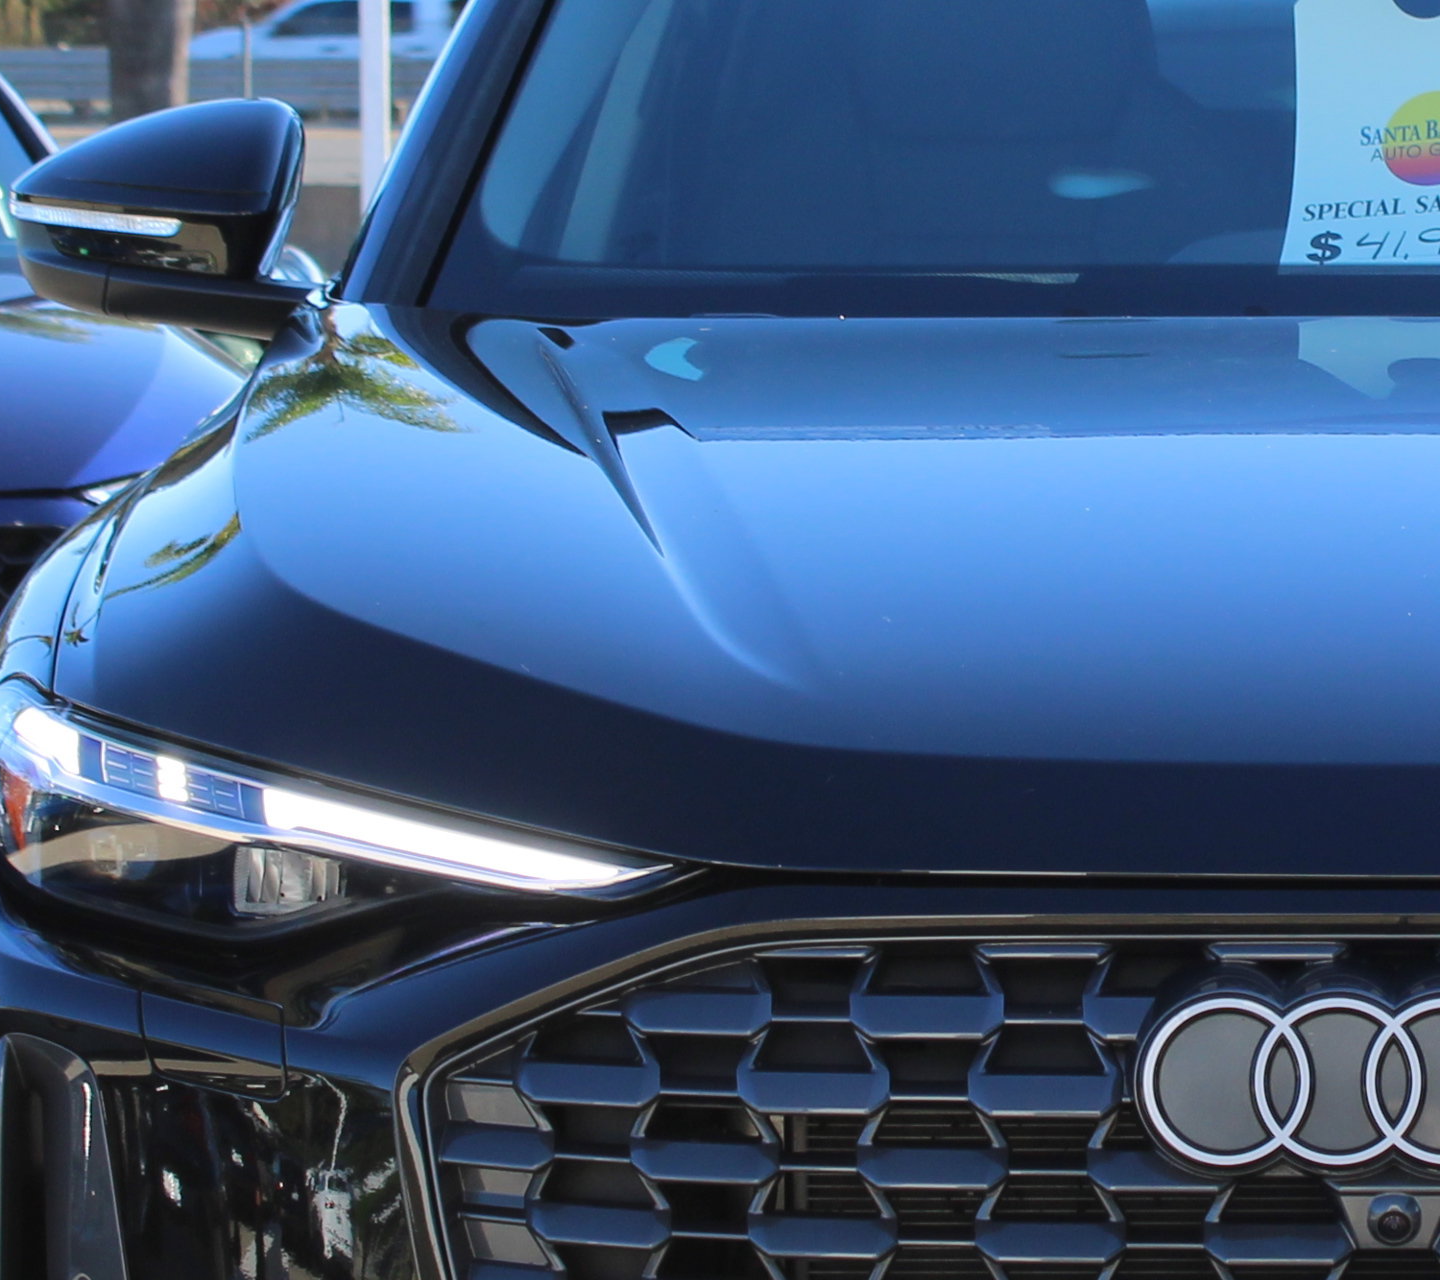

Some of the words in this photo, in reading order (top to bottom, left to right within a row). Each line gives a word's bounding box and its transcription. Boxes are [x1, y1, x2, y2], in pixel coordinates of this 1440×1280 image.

[1360, 125, 1422, 147] SANTA
[1370, 143, 1422, 162] AUTO
[1302, 197, 1406, 222] SPECIAL
